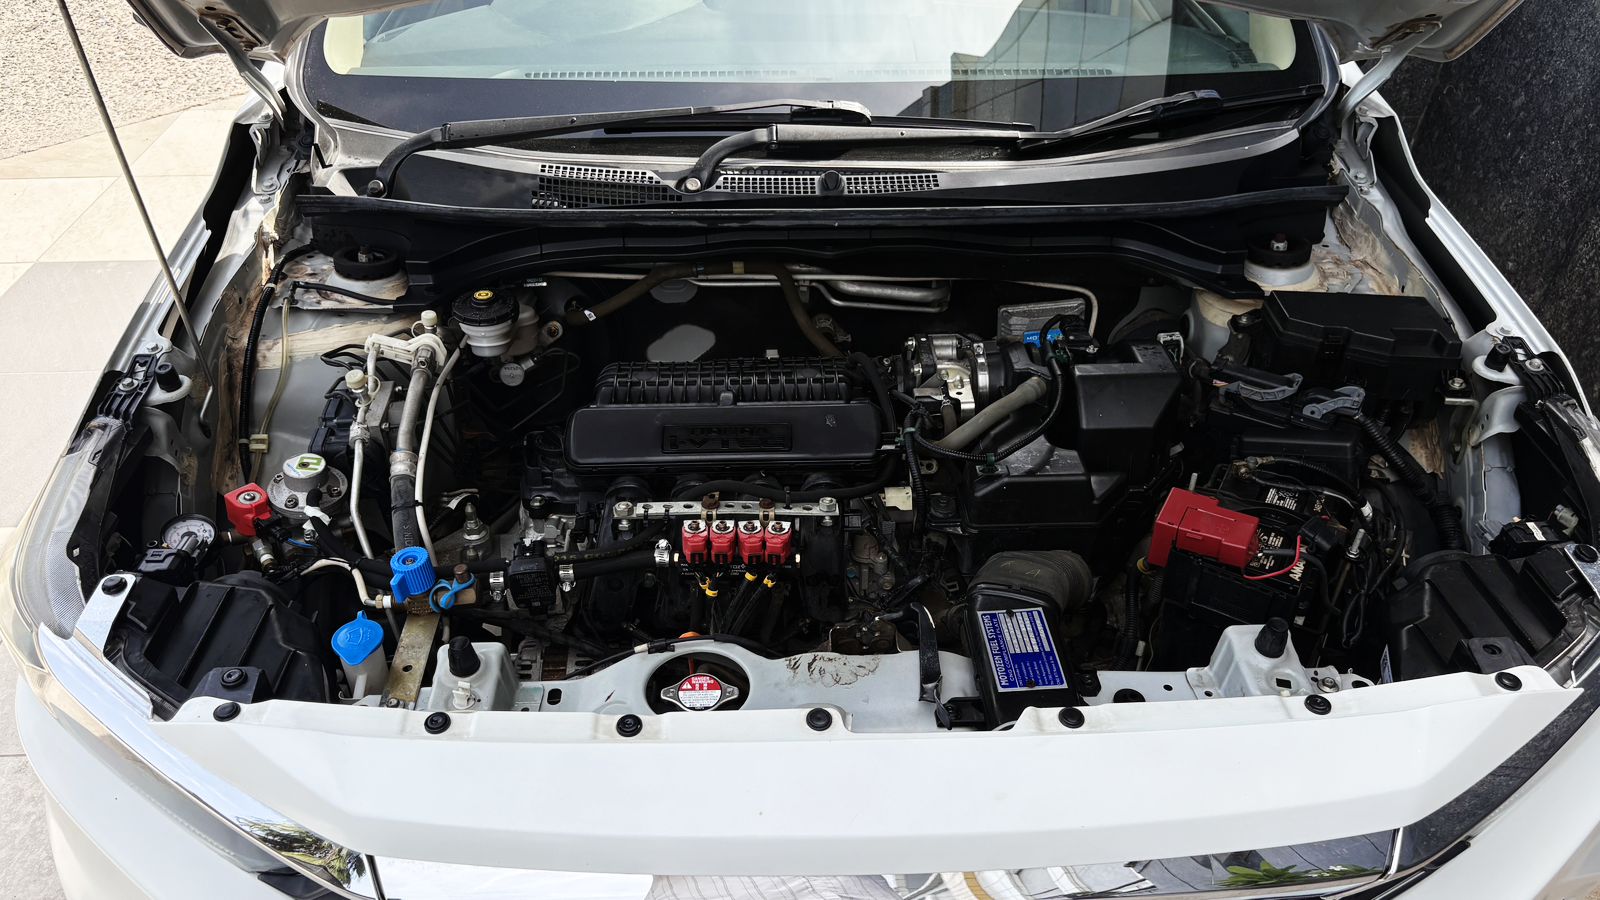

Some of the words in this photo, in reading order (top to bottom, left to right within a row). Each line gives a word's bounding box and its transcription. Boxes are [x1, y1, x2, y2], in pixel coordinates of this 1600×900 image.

[982, 614, 996, 638] SYSTEMS
[992, 618, 1000, 633] PLATE
[989, 639, 1000, 653] FUEL
[997, 634, 1011, 668] COMPLIANCE
[993, 655, 1009, 685] MOTOZEN
